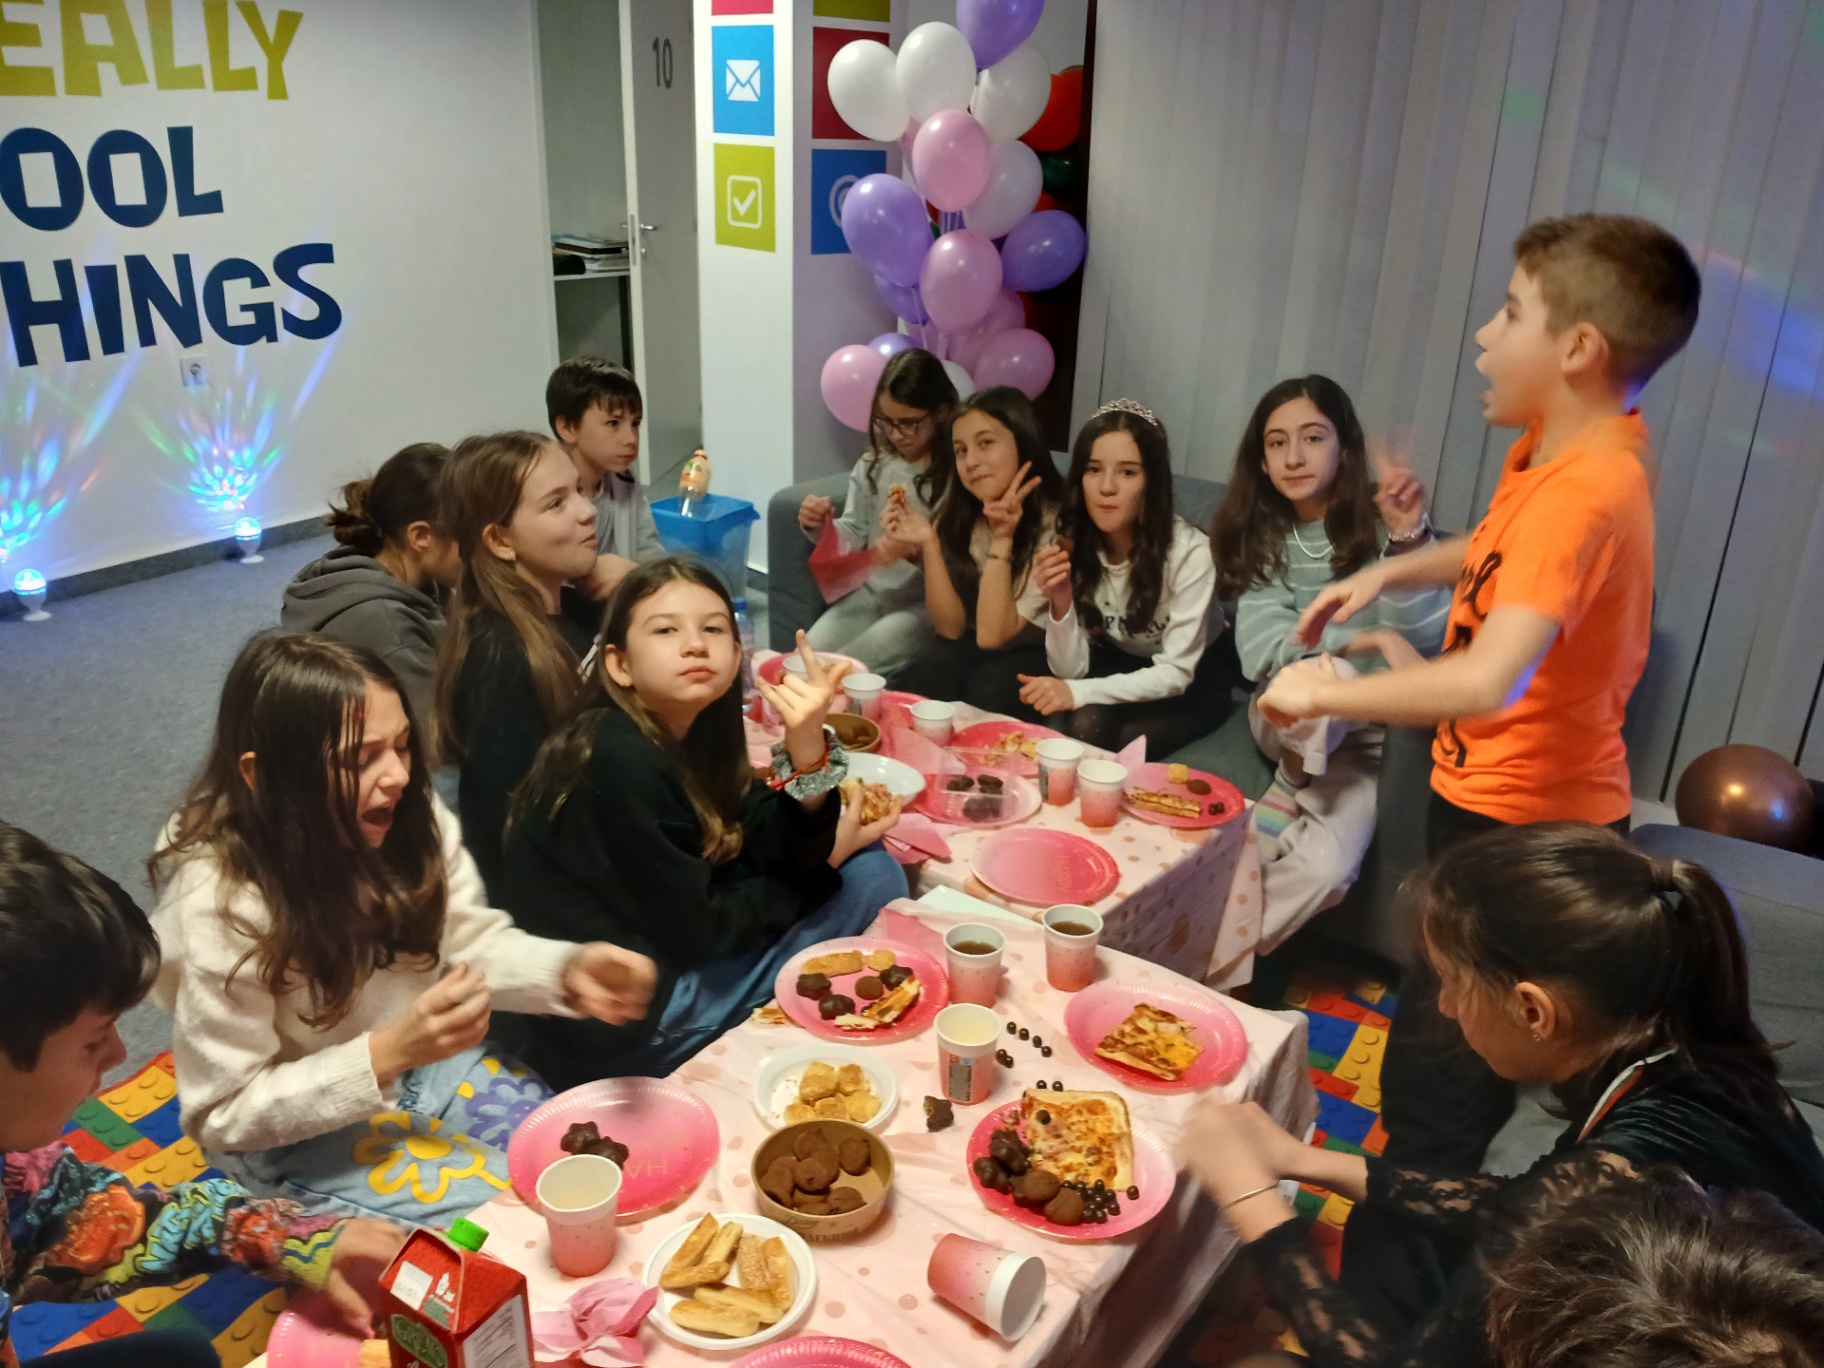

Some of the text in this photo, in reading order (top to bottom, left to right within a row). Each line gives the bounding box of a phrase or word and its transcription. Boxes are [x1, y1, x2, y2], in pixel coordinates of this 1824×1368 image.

[0, 0, 304, 100] EALLY
[652, 36, 674, 89] 10
[0, 126, 224, 231] OOL
[0, 243, 342, 367] HINGS
[623, 1157, 669, 1179] HA
